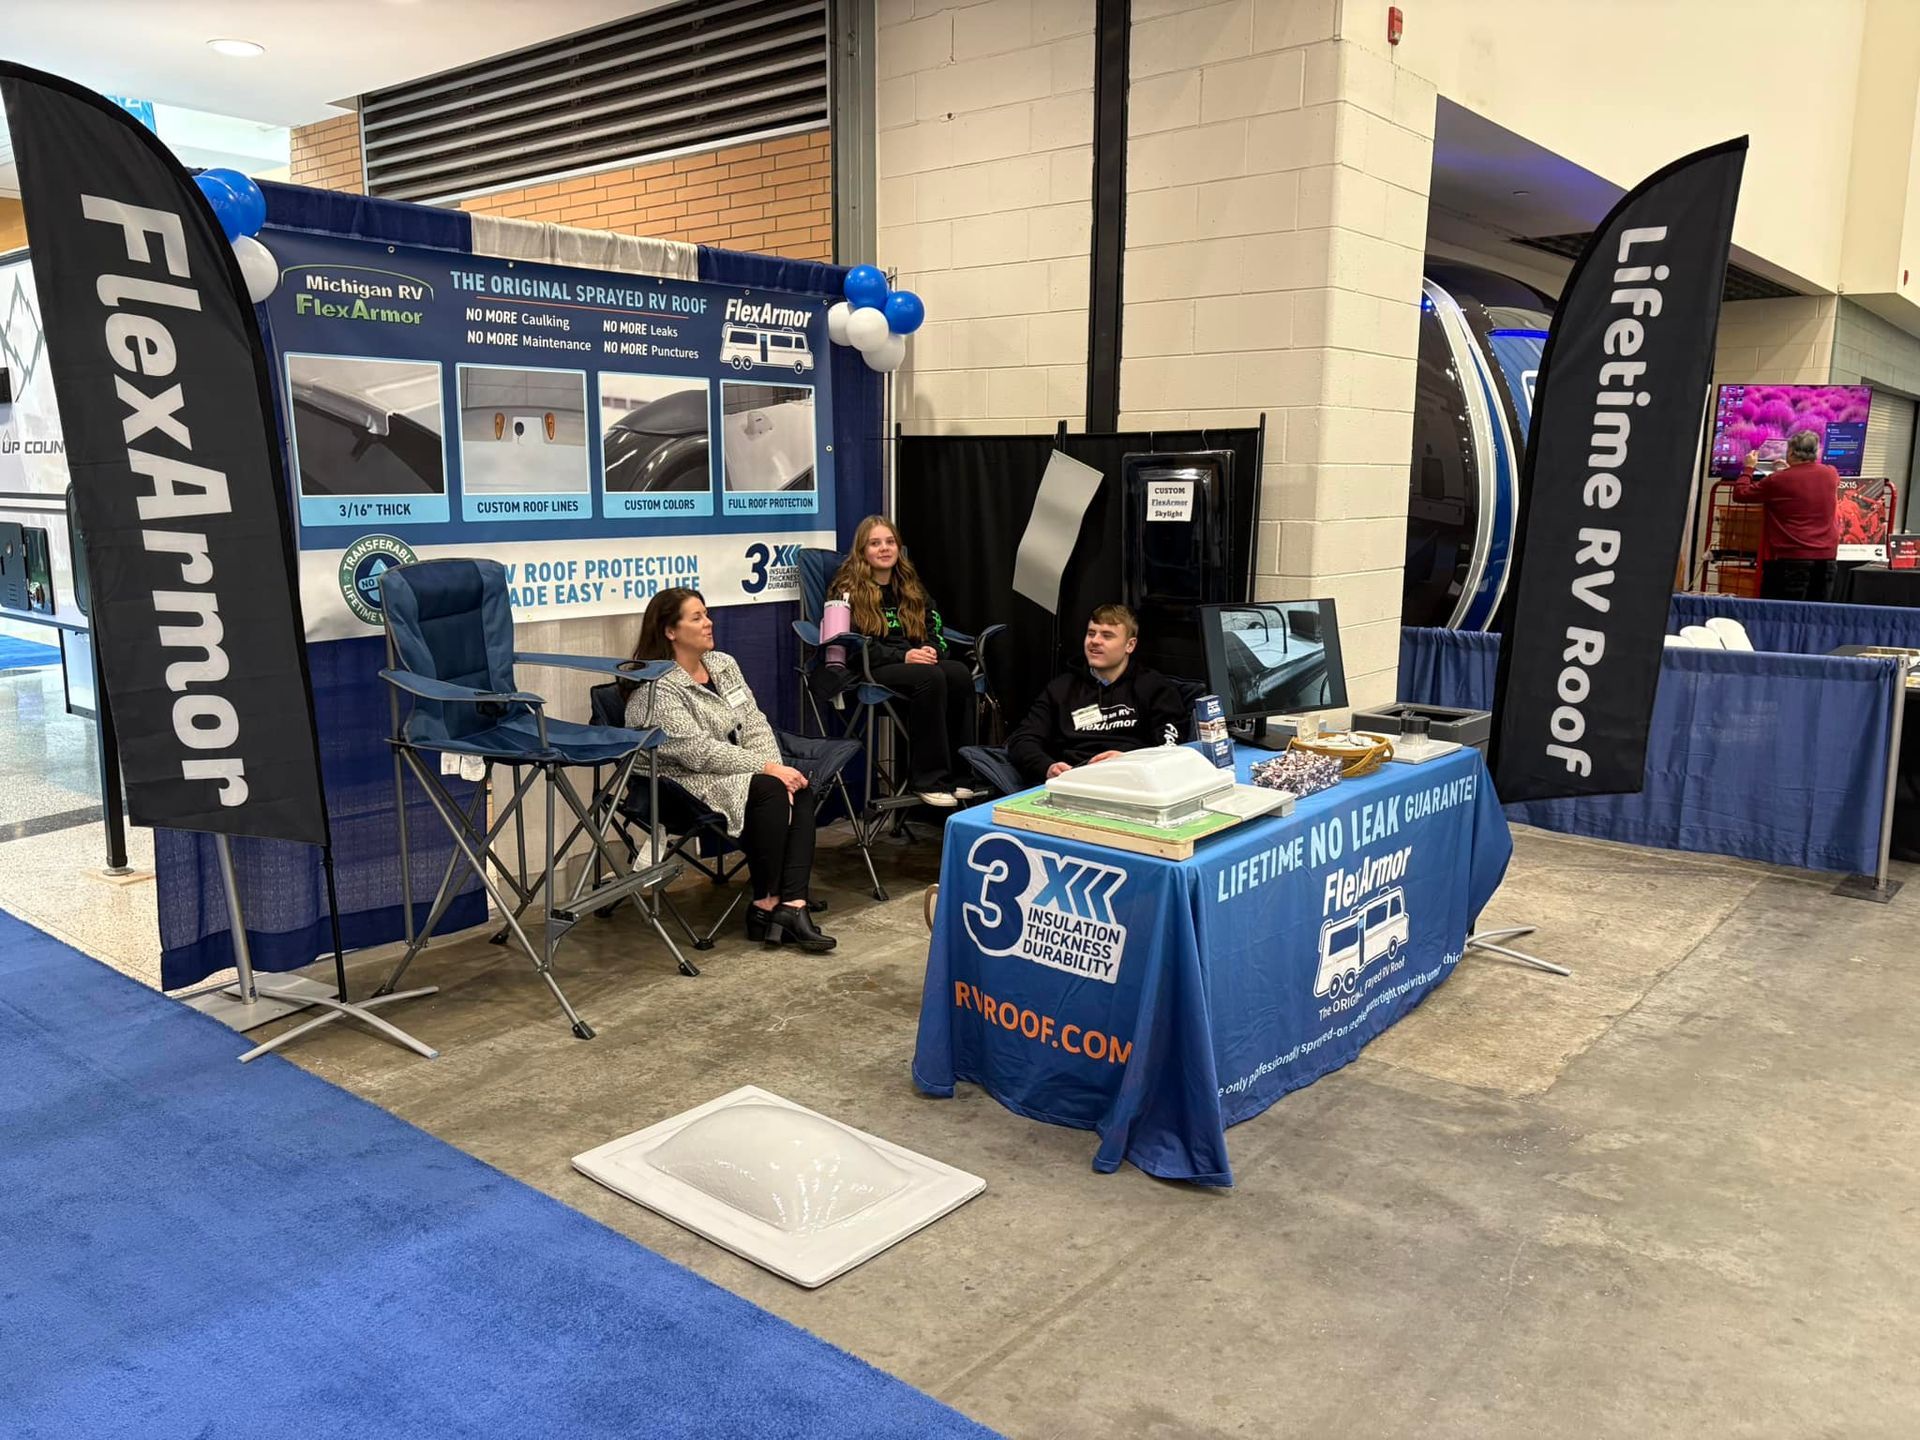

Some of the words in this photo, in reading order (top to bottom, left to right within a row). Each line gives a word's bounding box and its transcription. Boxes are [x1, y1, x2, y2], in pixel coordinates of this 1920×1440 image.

[306, 275, 392, 299] Michigan
[399, 285, 423, 300] RV
[450, 271, 485, 292] THE
[491, 275, 571, 300] ORIGINAL
[576, 285, 644, 308] SPRAYED
[649, 292, 666, 310] RV
[672, 295, 707, 314] ROOF
[296, 293, 423, 324] FlexArmor
[466, 308, 482, 322] NO
[485, 310, 517, 324] MORE
[521, 313, 570, 331] Caulking
[725, 299, 812, 328] FlexArmor
[467, 331, 483, 344] NO
[487, 332, 518, 346] MORE
[522, 335, 591, 351] Maintenance
[603, 320, 617, 333] NO
[620, 321, 647, 336] MORE
[650, 325, 678, 338] Leaks
[604, 341, 617, 354] NO
[620, 343, 647, 356] MORE
[651, 346, 699, 359] Punctures
[1583, 226, 1670, 510] Lifetime
[2, 441, 20, 454] UP
[25, 441, 64, 454] COUN
[81, 194, 250, 807] FlexArmor
[728, 498, 747, 508] FULL
[749, 498, 767, 508] ROOF
[769, 497, 813, 508] PROTECTION
[1155, 487, 1185, 495] CUSTOM
[376, 503, 411, 516] THICK
[477, 502, 520, 514] CUSTOM
[523, 501, 549, 513] ROOF
[552, 501, 578, 512] LINES
[624, 500, 661, 510] CUSTOM
[663, 499, 695, 510] COLORS
[1155, 510, 1183, 518] Skylight
[504, 564, 516, 584] V
[524, 561, 578, 584] ROOF
[585, 555, 698, 580] PROTECTION
[769, 567, 800, 575] INSULATIO
[1571, 527, 1621, 614] RV
[361, 579, 375, 589] NO
[509, 585, 548, 608] ADE
[555, 582, 604, 604] EASY
[623, 578, 658, 599] FOR
[344, 584, 377, 622] LIFETIME
[1545, 625, 1606, 778] Roof
[1218, 836, 1304, 903] LIFETIME
[1310, 816, 1343, 869] NO
[1352, 795, 1401, 852] LEAK
[1028, 907, 1121, 945] INSULATION
[1027, 923, 1111, 959] THICKNESS
[1023, 939, 1114, 976] DURABILITY
[955, 980, 1133, 1064] RVROOF.COM
[1319, 1005, 1332, 1021] The
[1226, 1077, 1248, 1092] only
